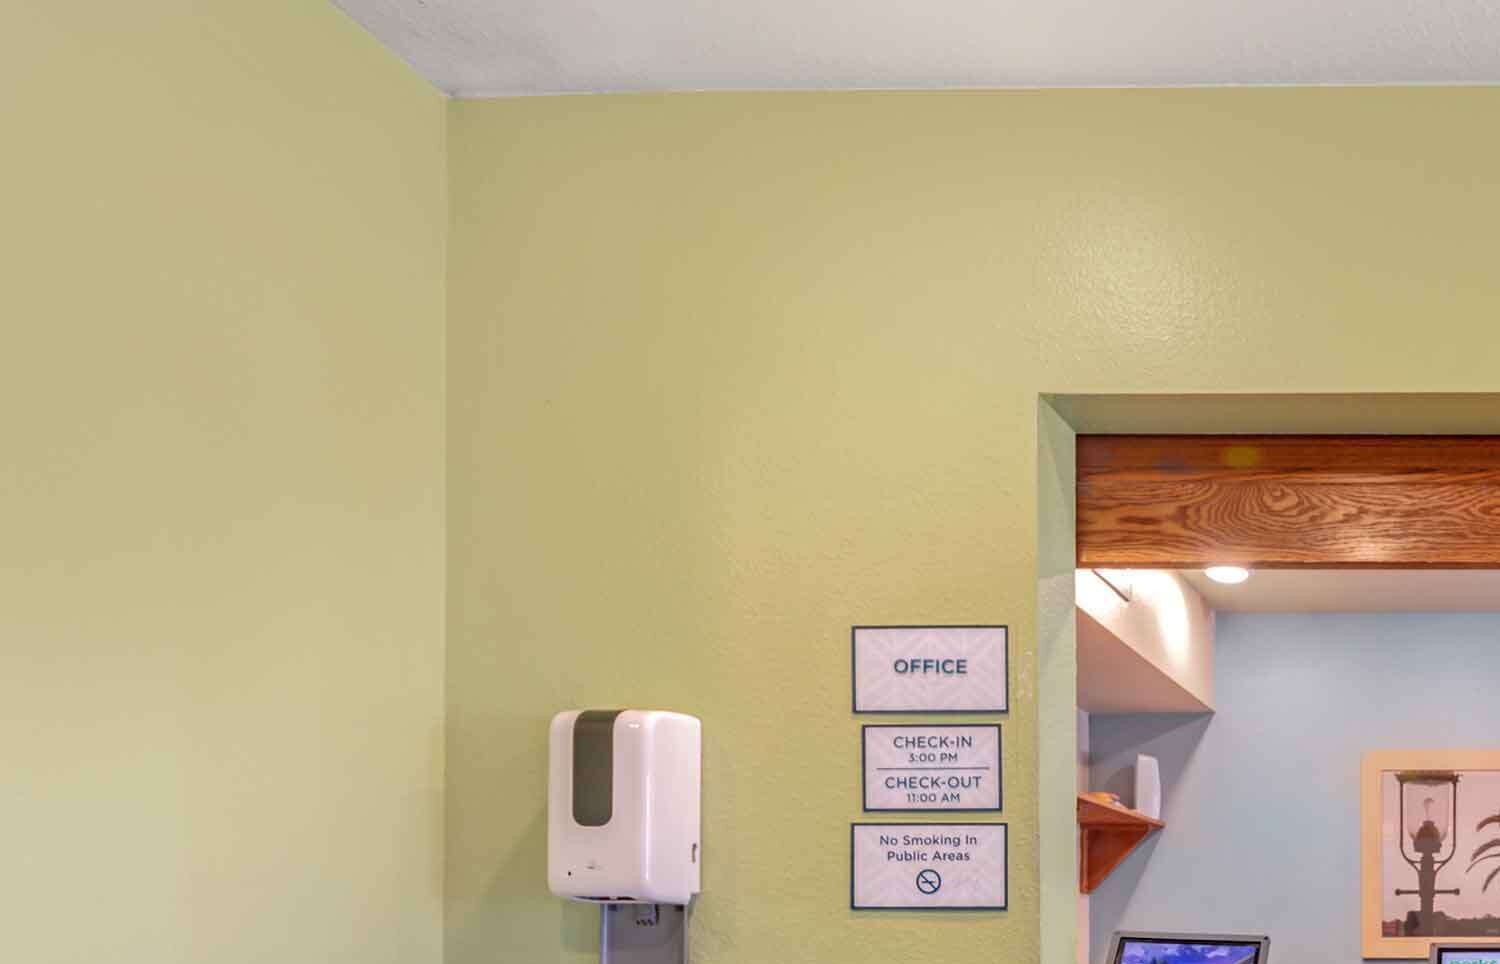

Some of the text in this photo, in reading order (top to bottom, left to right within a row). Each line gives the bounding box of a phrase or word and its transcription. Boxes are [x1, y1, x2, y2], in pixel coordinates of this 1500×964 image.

[894, 658, 968, 675] OFFICE
[893, 735, 972, 749] CHECK-IN
[909, 752, 958, 762] 3:00 PM
[885, 776, 982, 790] CHECK-OUT
[906, 793, 961, 803] 11:00 AM
[880, 834, 977, 847] No Smoking In
[887, 850, 970, 862] Public Areas
